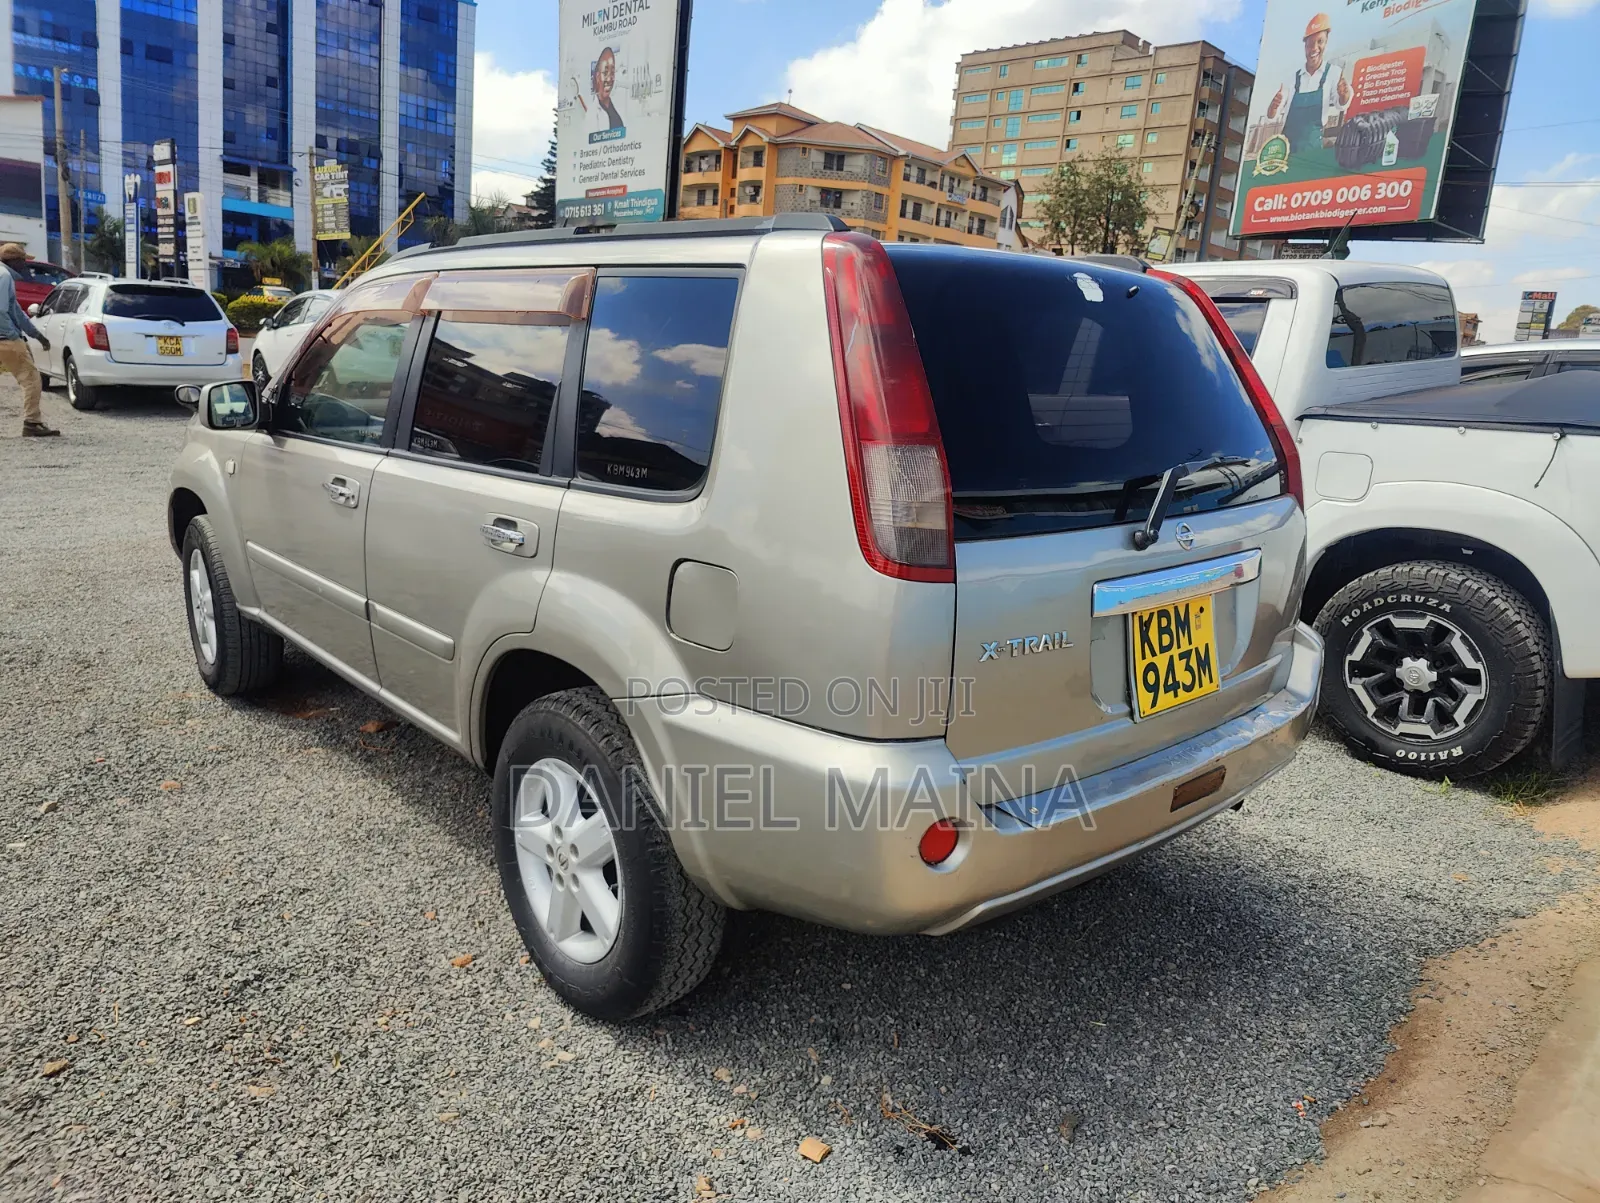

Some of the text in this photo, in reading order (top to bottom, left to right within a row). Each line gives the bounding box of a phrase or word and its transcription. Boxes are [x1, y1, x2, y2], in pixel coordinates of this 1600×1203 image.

[612, 0, 650, 18] DENTAL
[1383, 0, 1432, 19] Biodig
[593, 20, 617, 36] KIAMBU
[619, 16, 638, 29] ROAD
[1366, 60, 1405, 72] Biodigester
[1365, 68, 1407, 81] Grease Trap
[1362, 83, 1405, 97] Tazo natural
[1363, 77, 1406, 89] Bio Enzymes
[1360, 92, 1411, 105] home cleaners
[602, 130, 622, 140] Services
[579, 149, 598, 159] Braces
[602, 141, 642, 154] Orthodontics
[315, 165, 342, 174] LUXURY
[579, 156, 635, 171] Paediatric Dentistry
[314, 170, 349, 181] CAR TINT
[579, 167, 646, 184] General Dental Services
[1254, 179, 1413, 212] Call: 0709 006 300
[565, 204, 580, 218] 0715
[580, 203, 592, 217] 613
[1269, 205, 1387, 223] www.biotankbiodigester.com
[1522, 291, 1556, 300] K-Mall
[164, 337, 181, 346] KCA
[160, 346, 182, 355] 550M
[606, 463, 648, 479] KBM943M
[1341, 593, 1452, 627] ROADCRUZA
[1138, 603, 1192, 661] KBM
[979, 630, 1074, 663] X-TRAIL
[1142, 643, 1213, 710] 943M
[1396, 745, 1464, 761] RA1100
